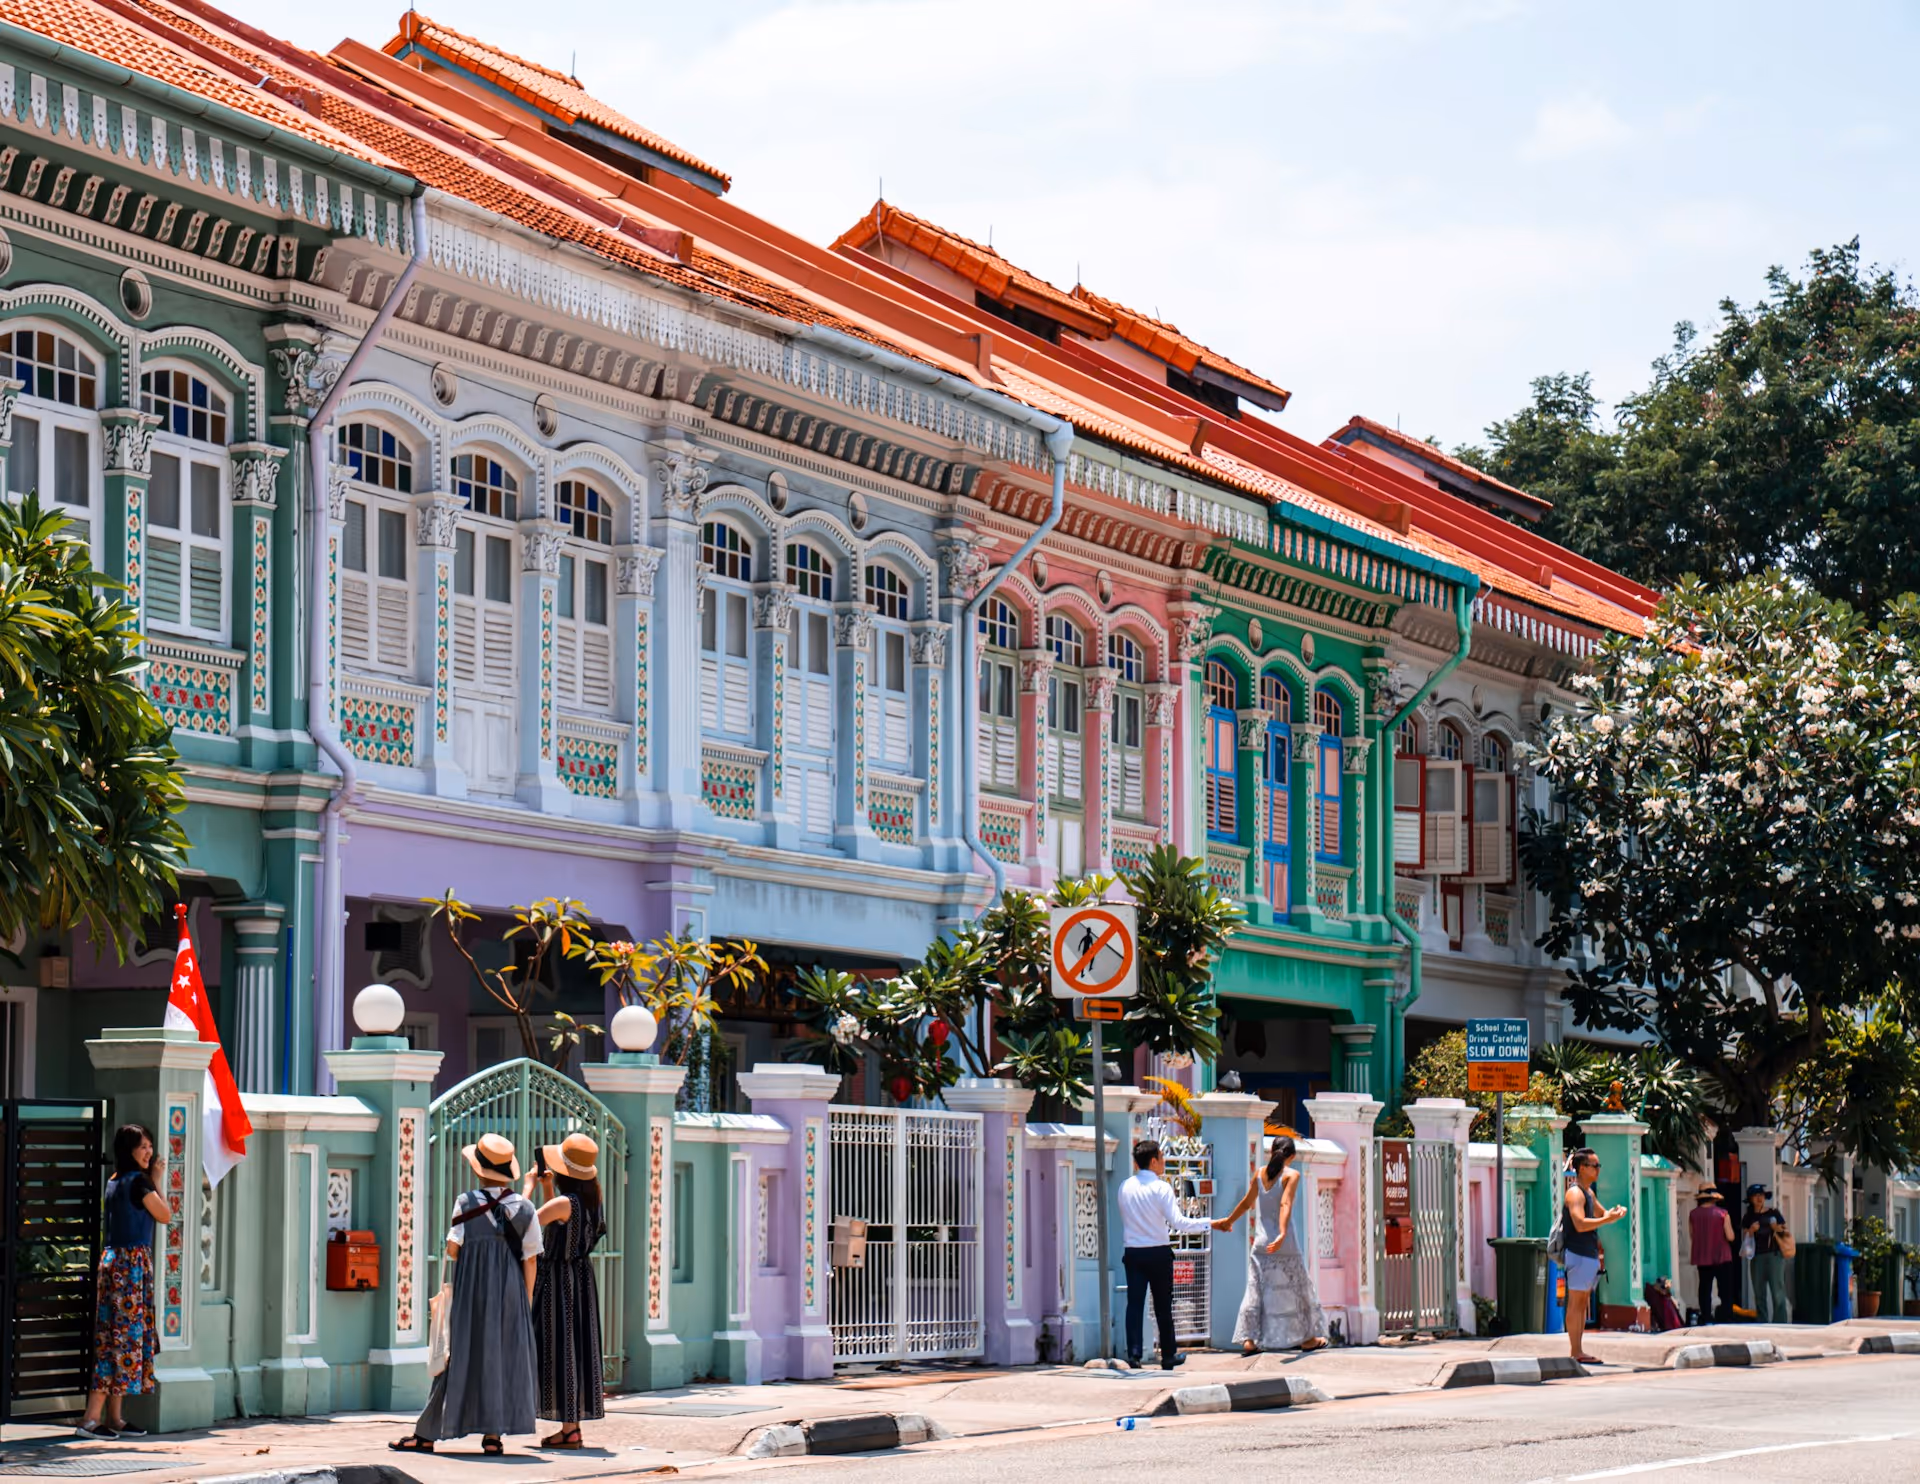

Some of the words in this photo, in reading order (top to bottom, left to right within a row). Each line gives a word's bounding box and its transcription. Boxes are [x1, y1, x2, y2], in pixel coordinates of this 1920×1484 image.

[1475, 1023, 1500, 1032] School
[1503, 1023, 1521, 1032] Zone
[1468, 1034, 1489, 1043] Drive
[1492, 1034, 1527, 1045] Carefully
[1468, 1045, 1496, 1057] SLOW
[1498, 1045, 1528, 1057] DOWN
